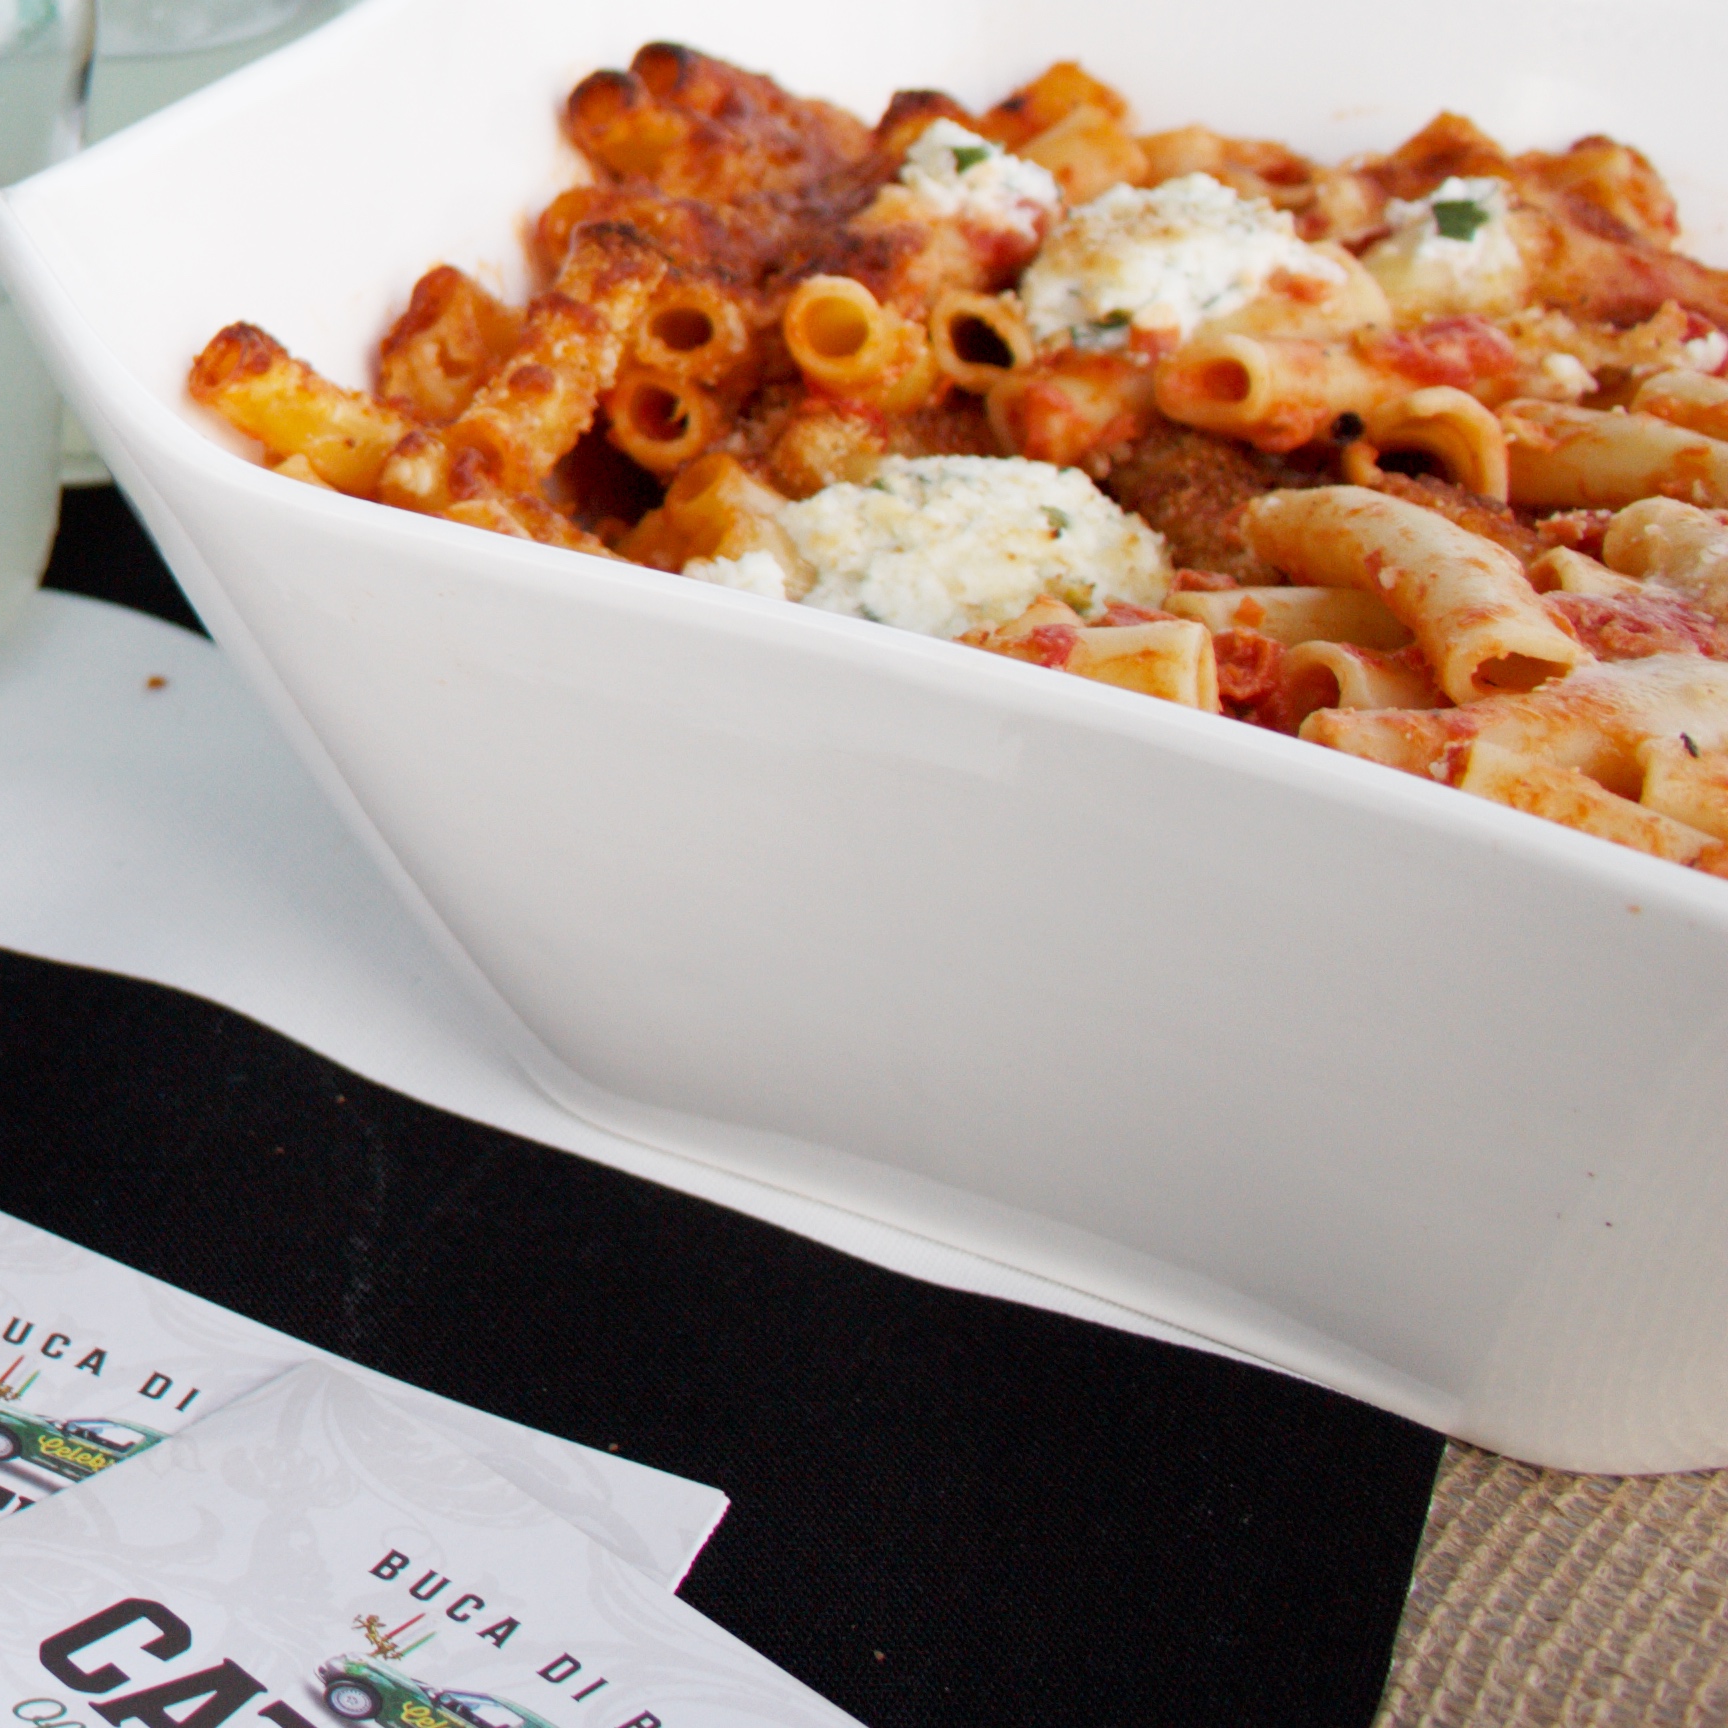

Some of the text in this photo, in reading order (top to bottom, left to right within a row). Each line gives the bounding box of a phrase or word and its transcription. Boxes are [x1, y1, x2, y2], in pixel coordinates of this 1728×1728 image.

[137, 1371, 201, 1413] DI
[367, 1548, 609, 1703] BUCA DI
